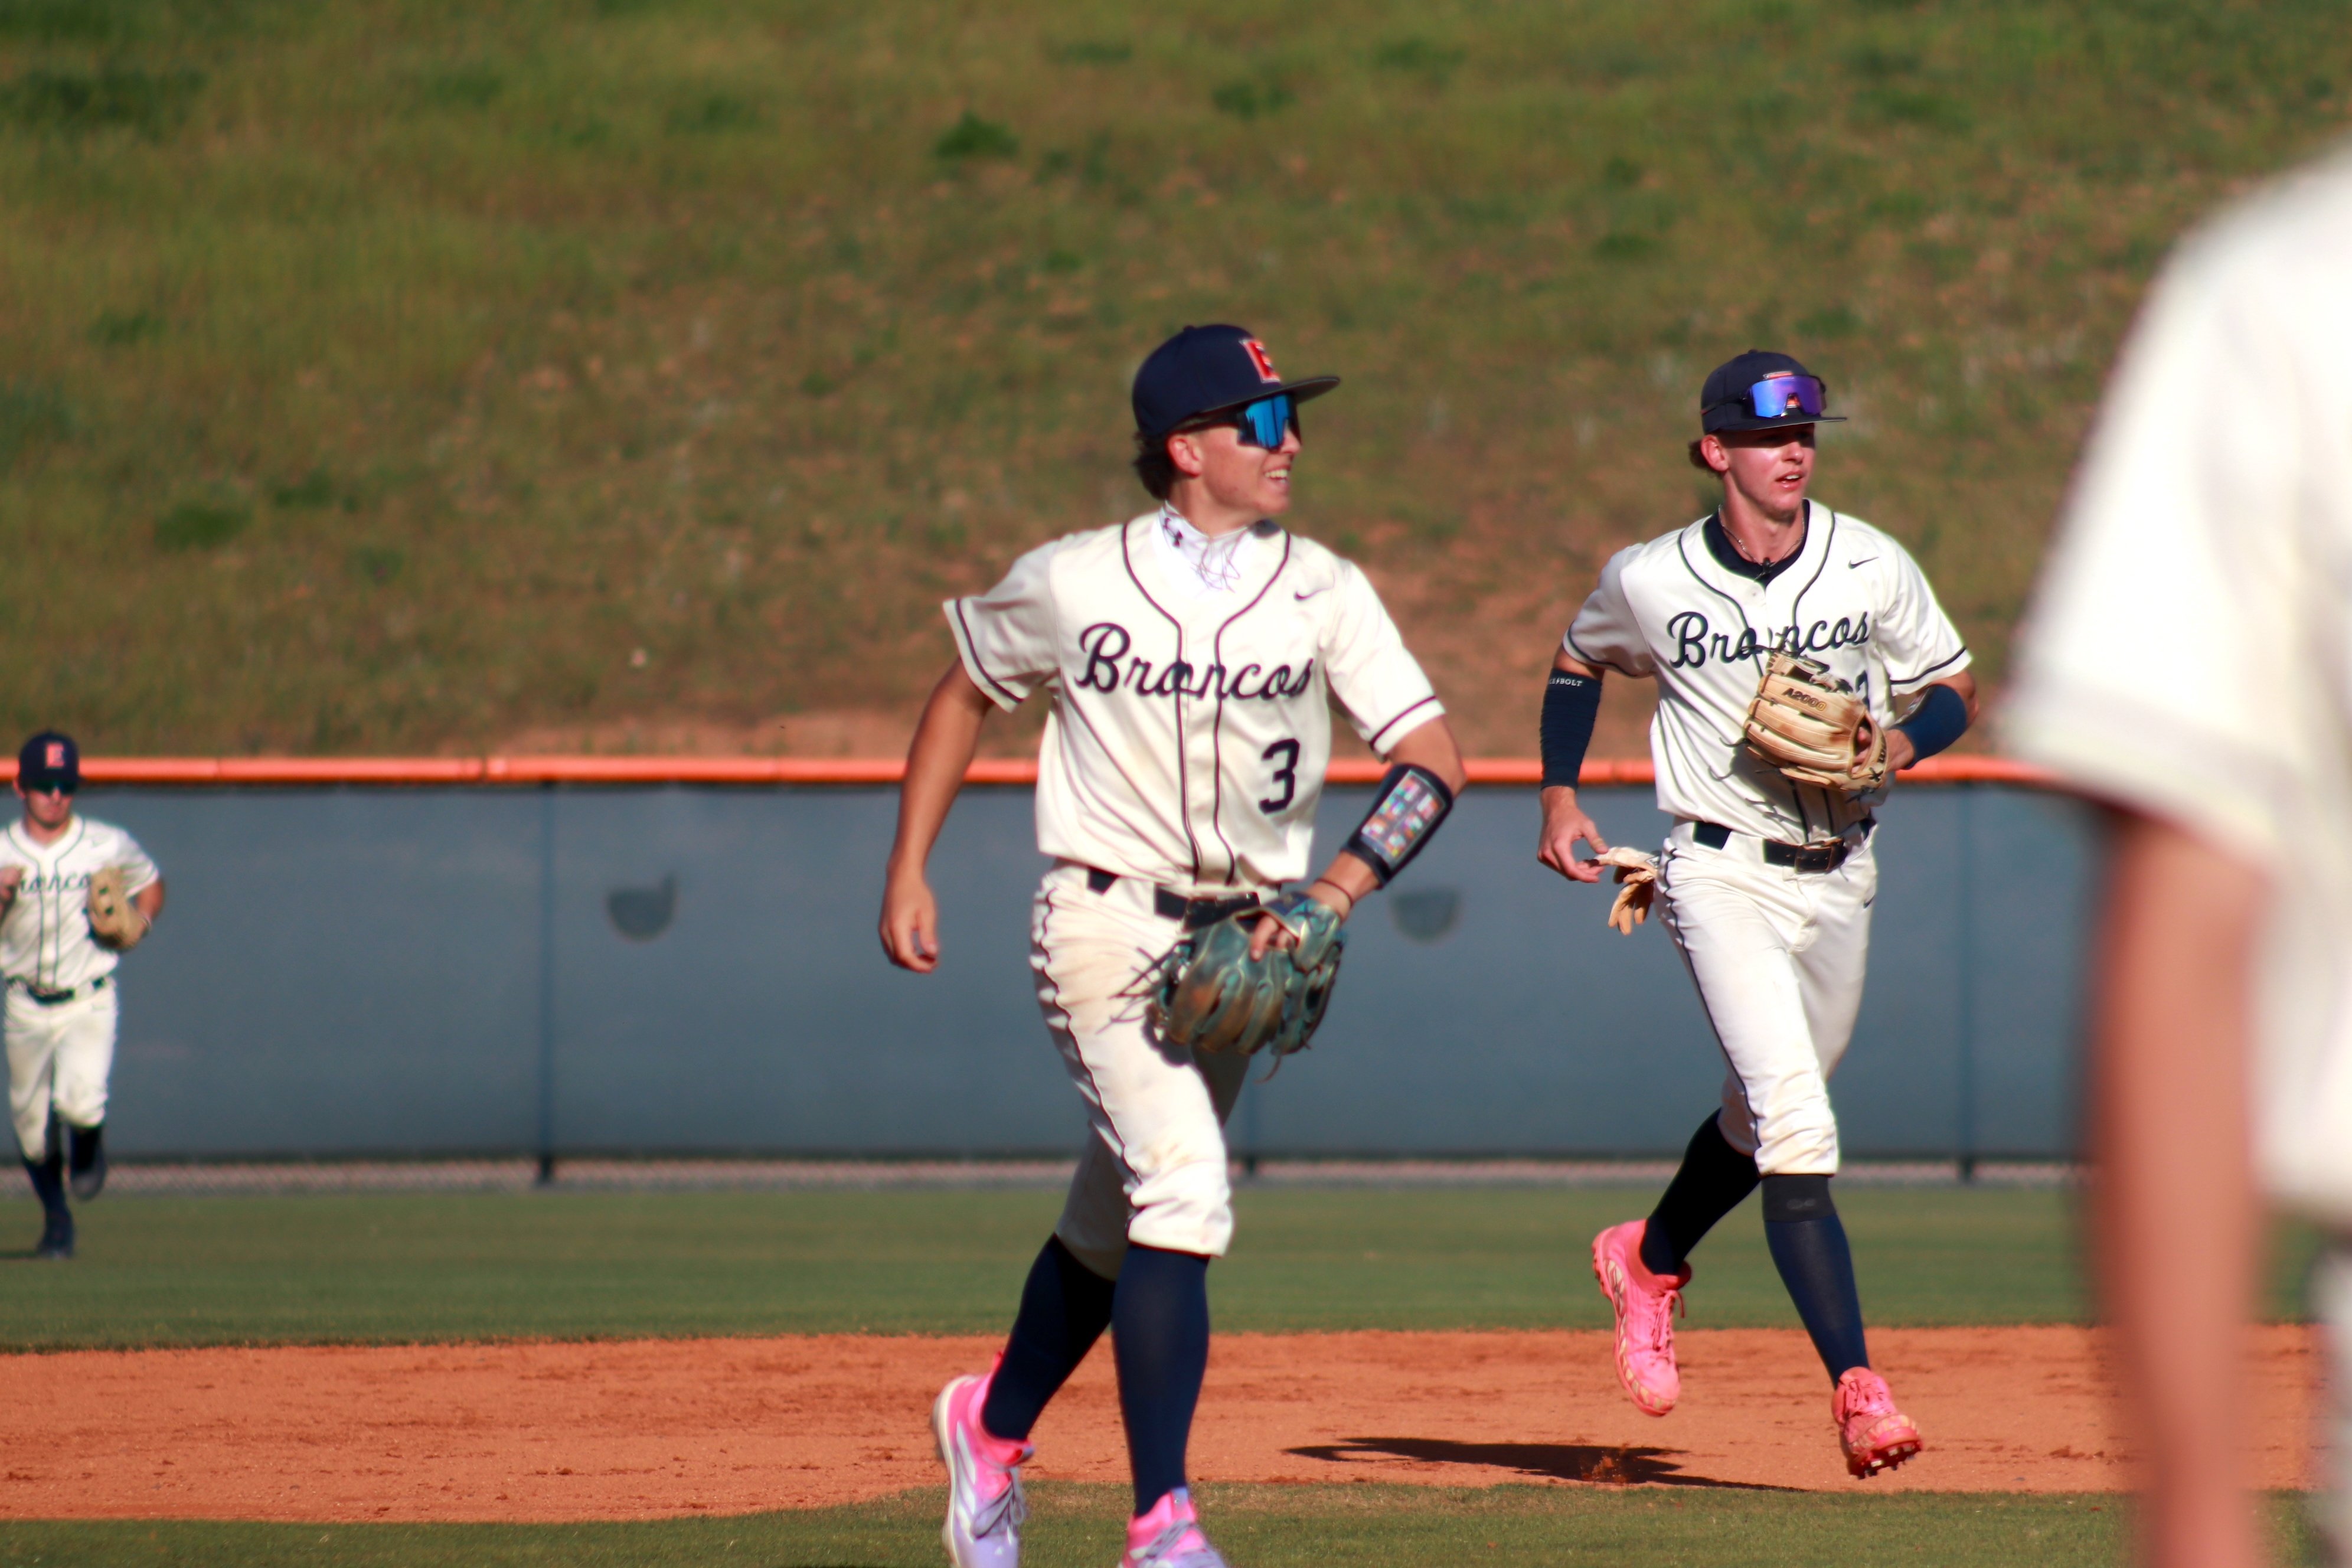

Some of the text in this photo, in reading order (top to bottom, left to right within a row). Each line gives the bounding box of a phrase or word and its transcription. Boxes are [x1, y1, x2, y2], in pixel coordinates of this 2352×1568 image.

[1239, 338, 1281, 384] E
[1074, 622, 1314, 701] Broncos
[1666, 610, 1870, 669] Broncos
[1782, 687, 1827, 711] A2000
[1259, 738, 1300, 815] 3
